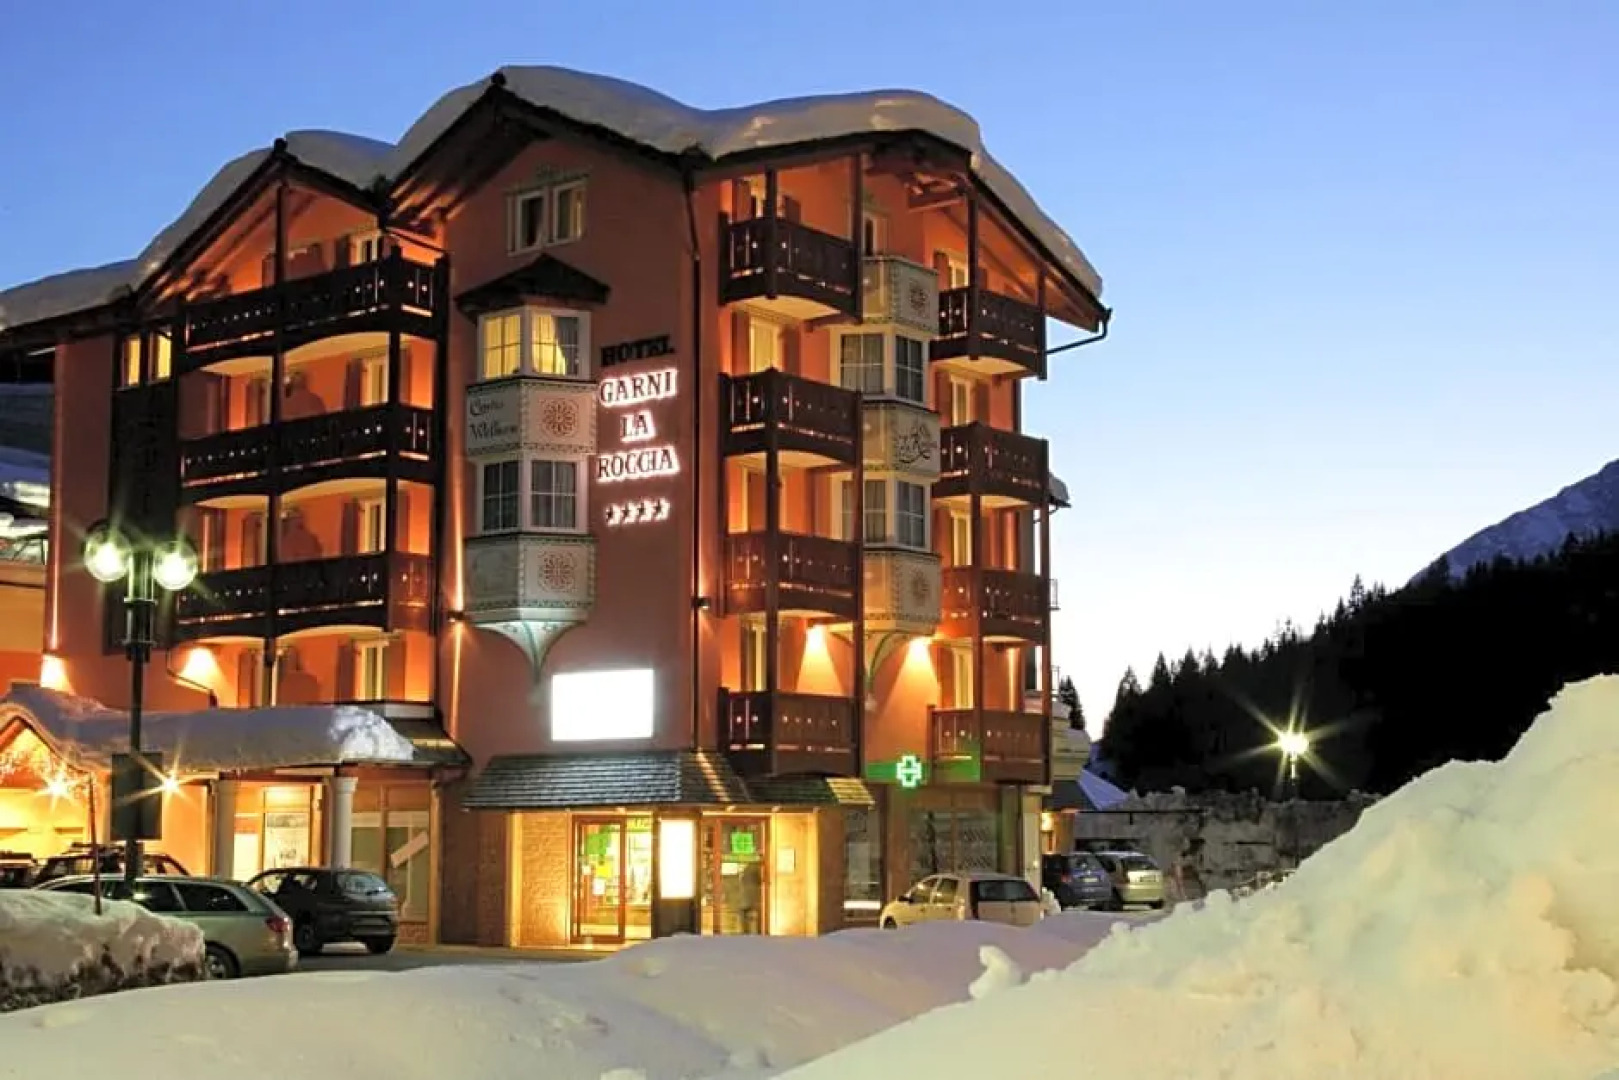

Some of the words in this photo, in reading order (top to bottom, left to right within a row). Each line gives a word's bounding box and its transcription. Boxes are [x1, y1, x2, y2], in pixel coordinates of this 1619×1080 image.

[601, 335, 675, 367] HOTEL
[600, 369, 675, 405] GARNI
[621, 412, 652, 440] LA
[597, 447, 676, 480] ROCCIA
